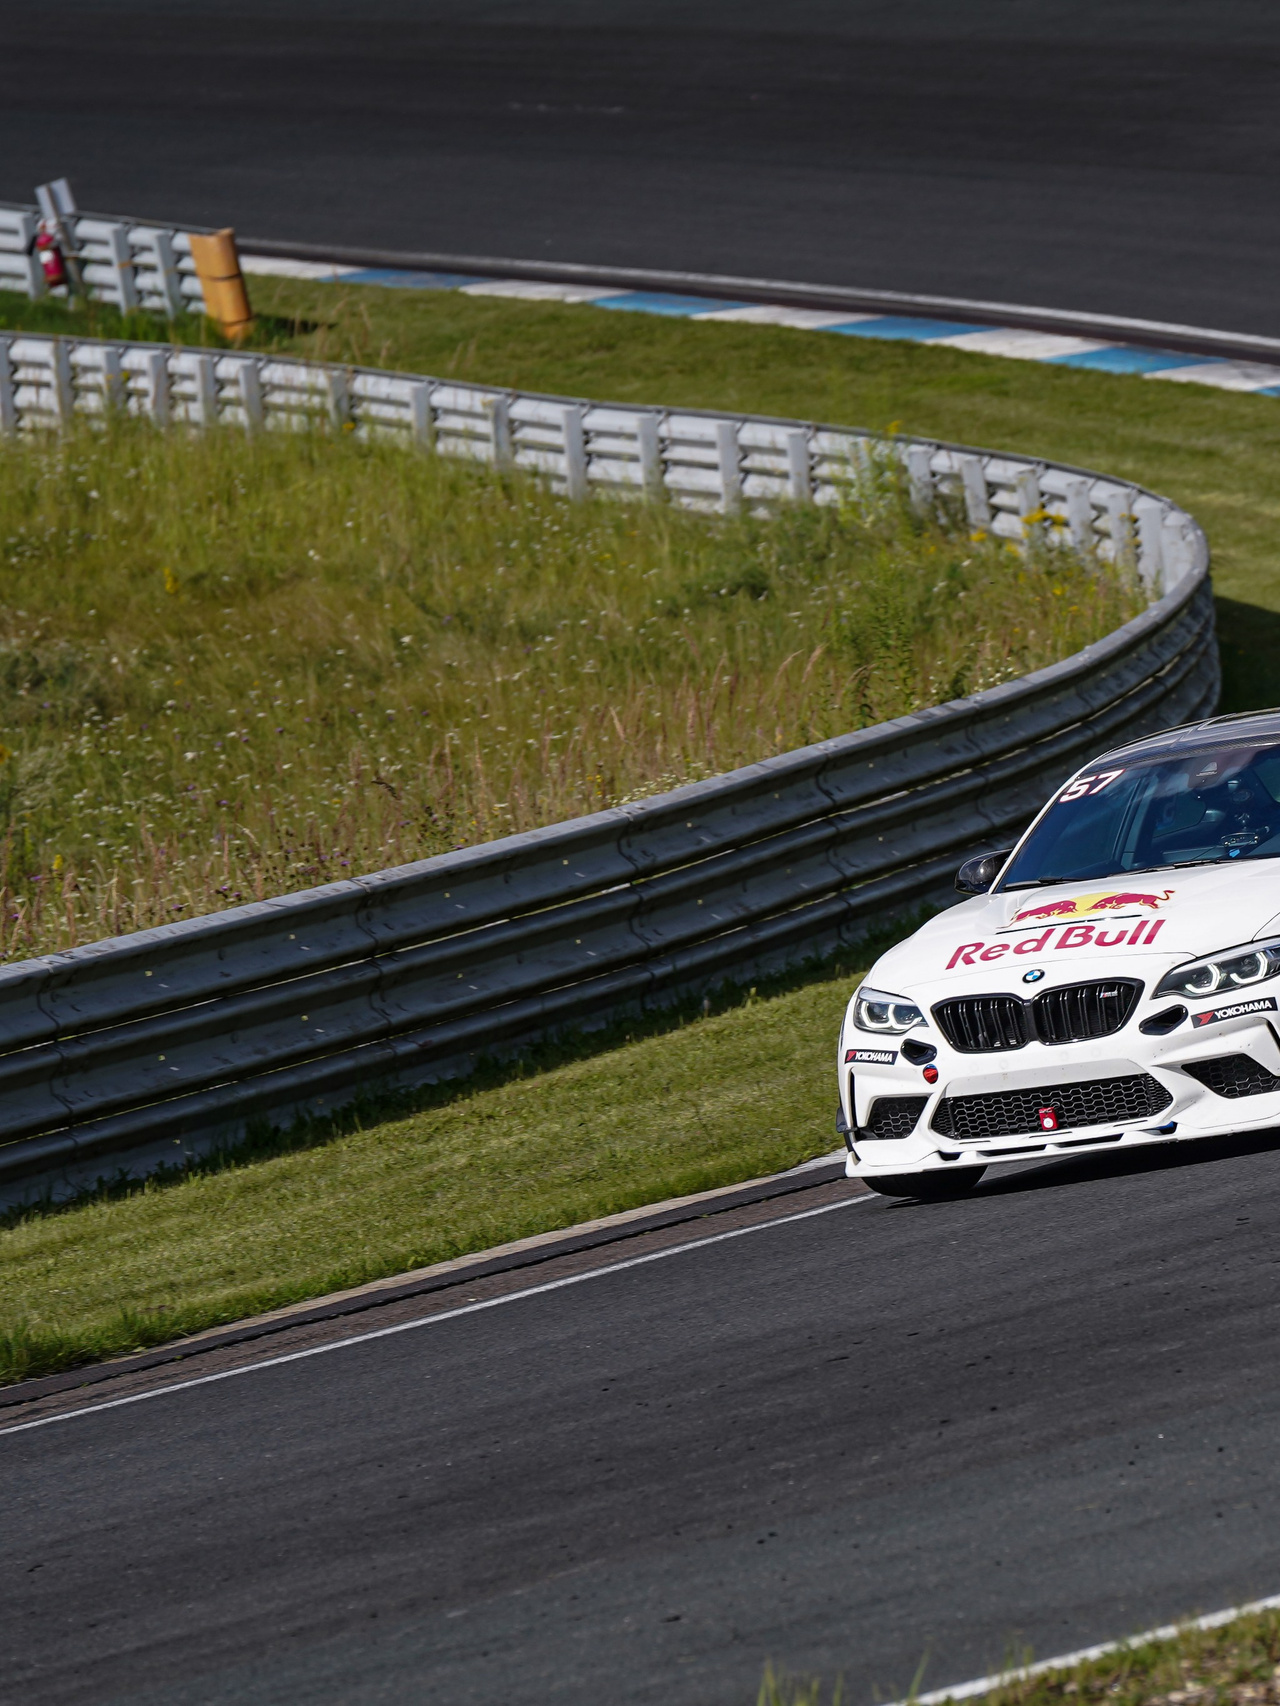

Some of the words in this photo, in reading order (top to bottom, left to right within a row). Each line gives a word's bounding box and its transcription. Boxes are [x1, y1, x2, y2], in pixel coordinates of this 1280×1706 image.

[1060, 768, 1126, 803] 57
[945, 928, 1055, 970] Red
[1054, 919, 1167, 949] Bull
[1214, 1000, 1272, 1019] YOKOHAMA
[855, 1051, 893, 1062] YOKOHAMA
